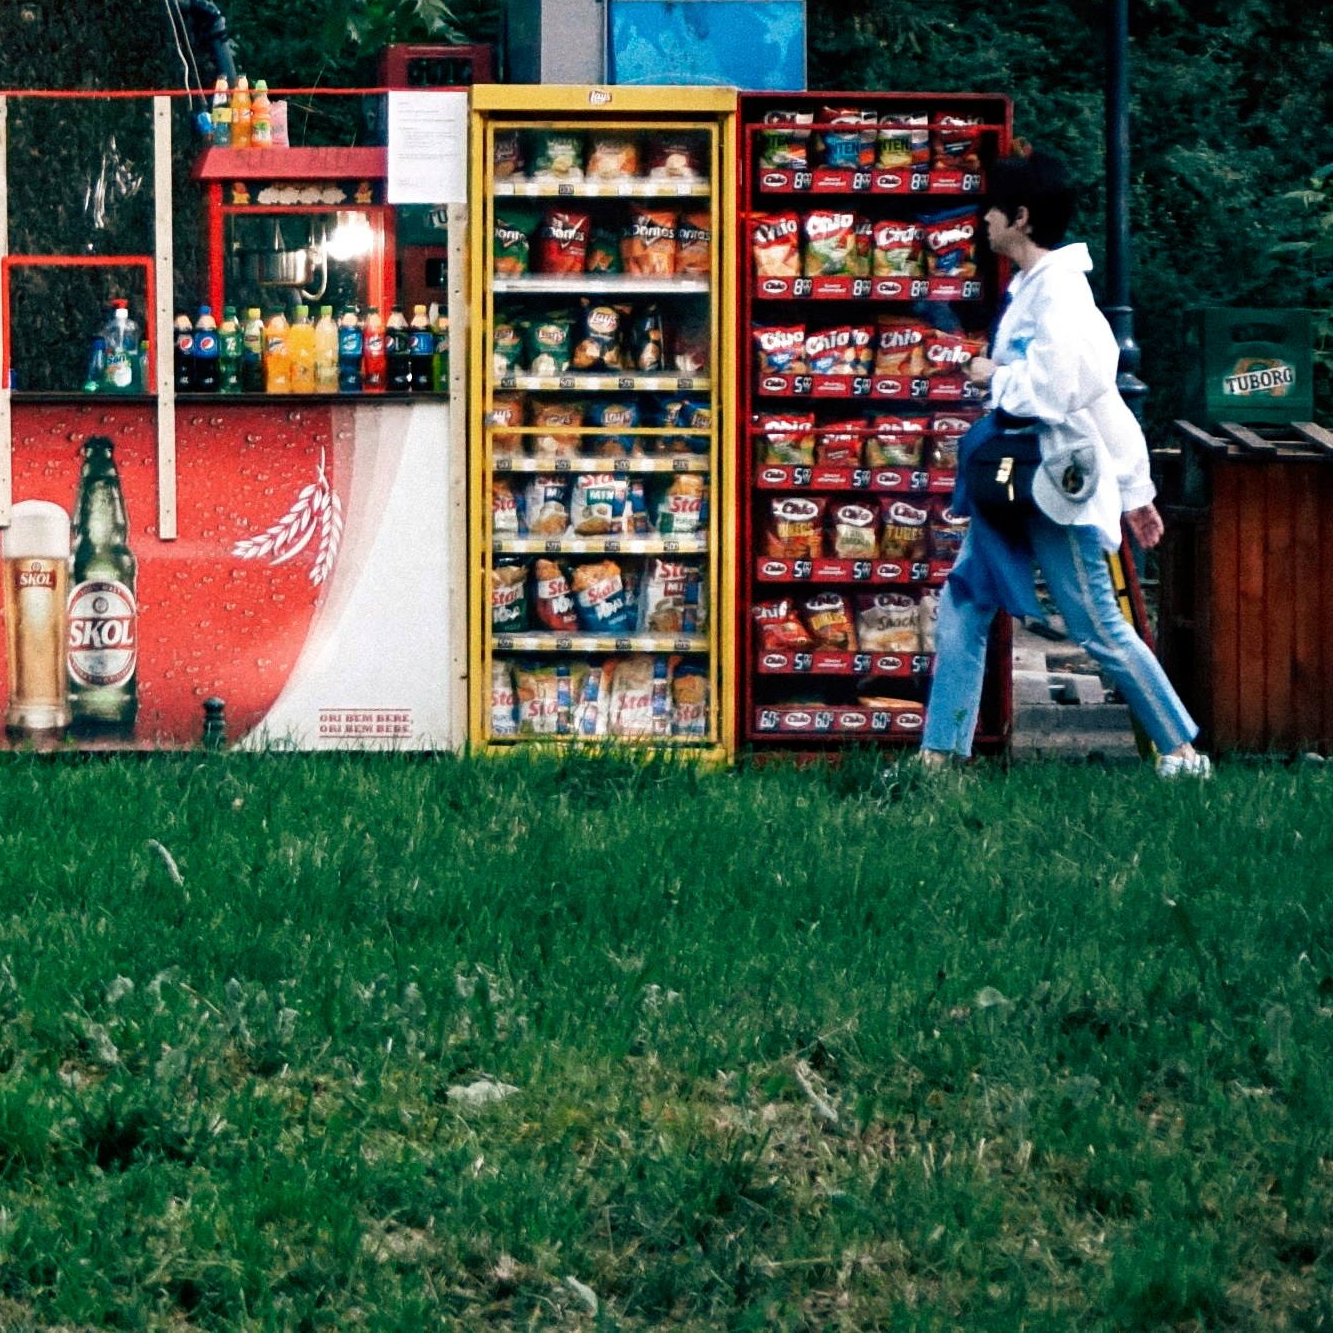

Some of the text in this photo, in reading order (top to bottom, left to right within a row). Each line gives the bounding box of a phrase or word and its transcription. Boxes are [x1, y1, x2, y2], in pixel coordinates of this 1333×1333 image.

[880, 328, 923, 349] Chio
[1225, 367, 1293, 393] TUBORG
[20, 572, 53, 586] SKOL
[69, 619, 134, 648] SKOL
